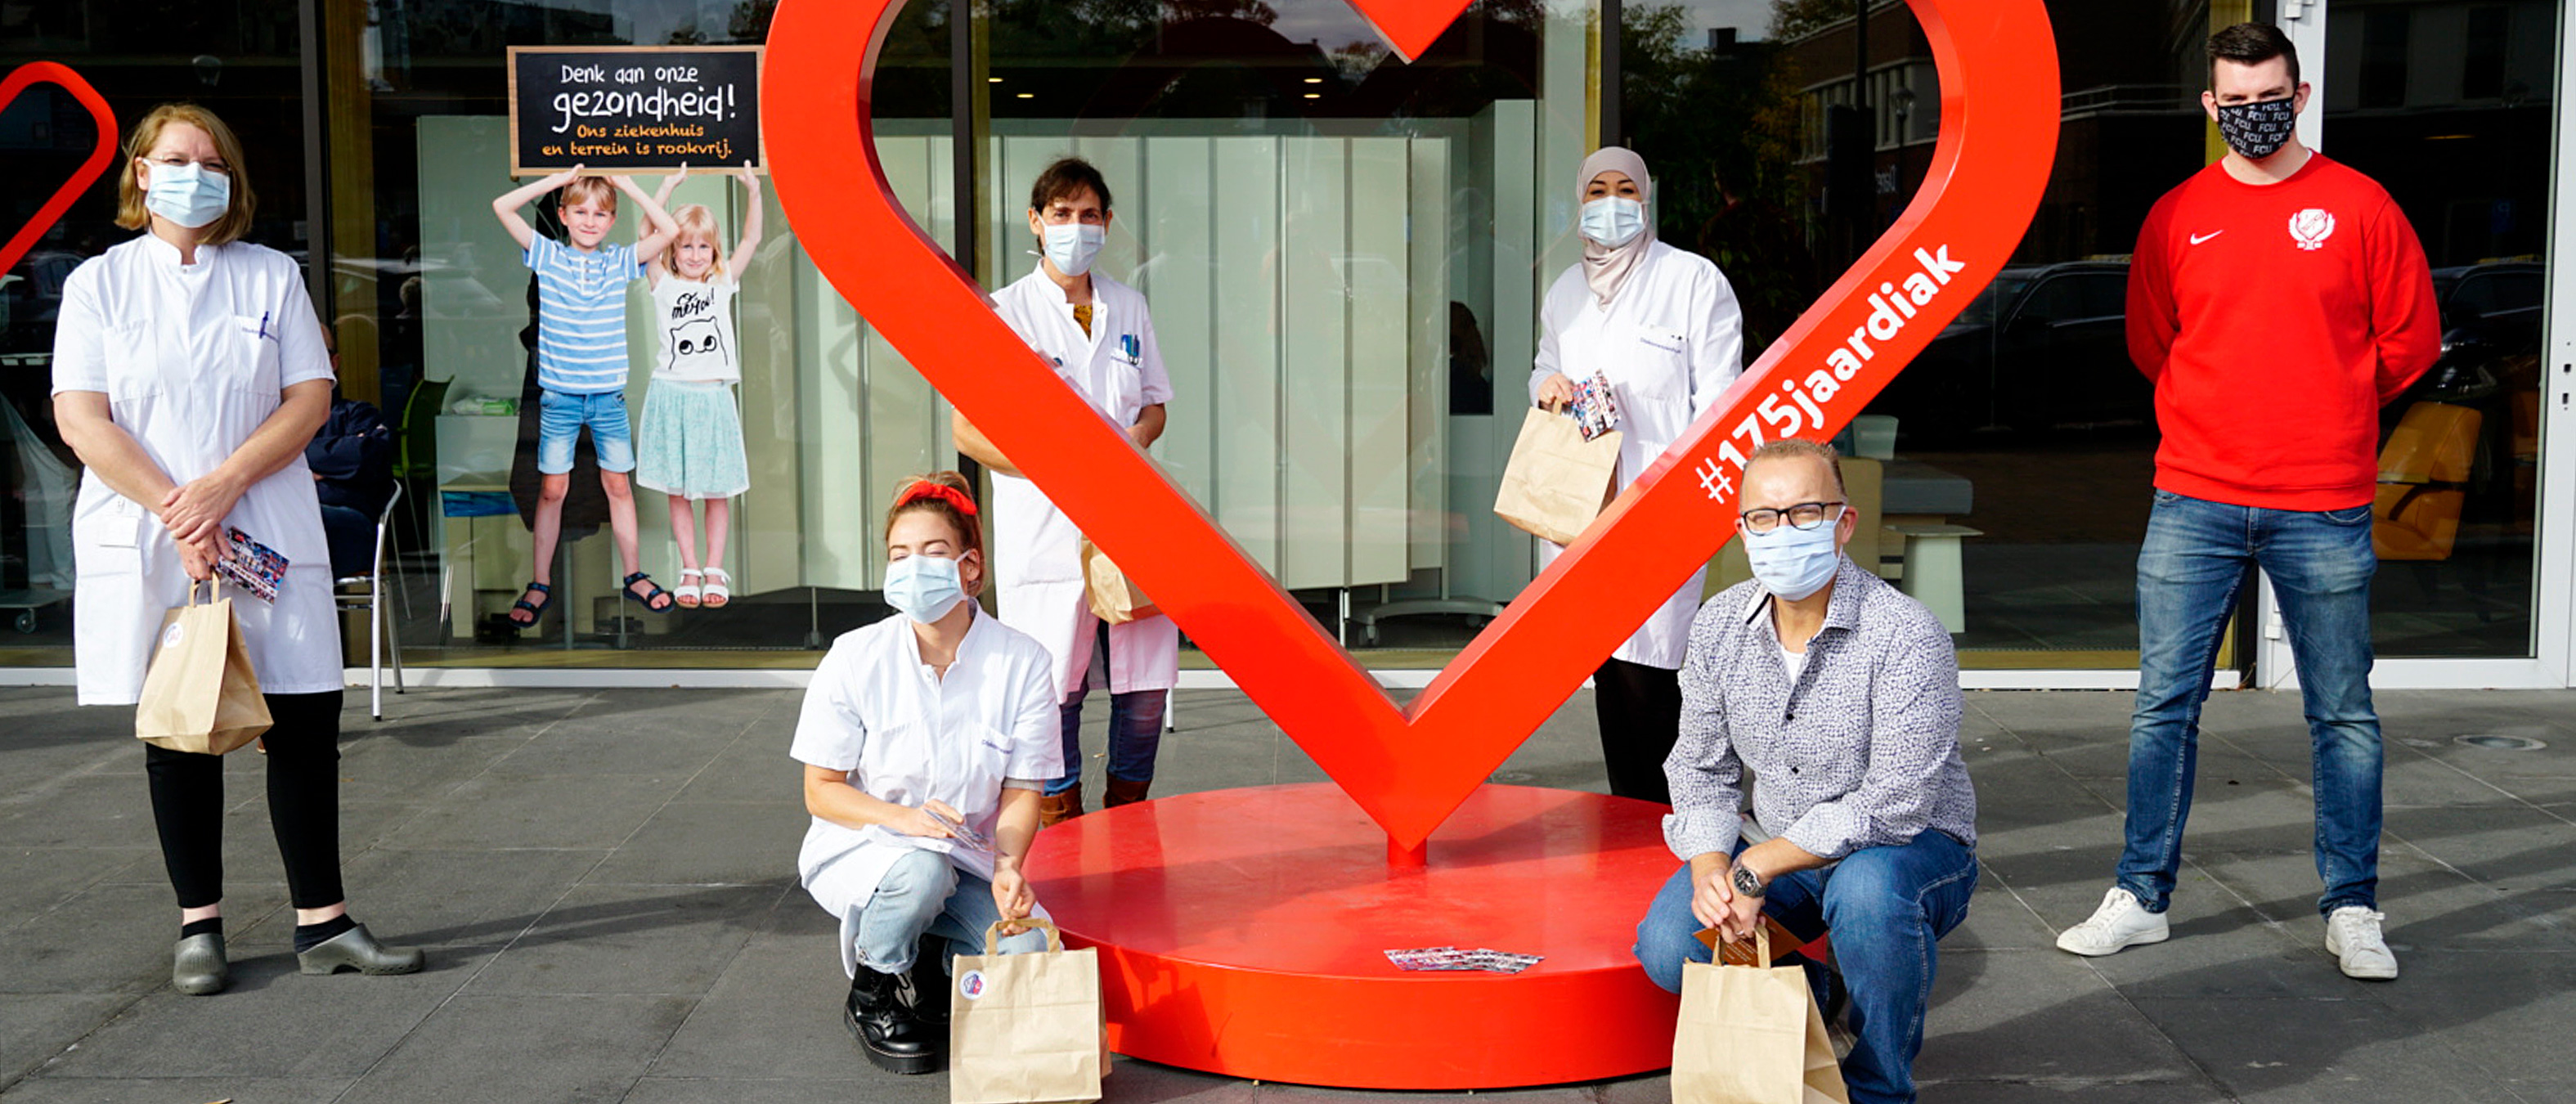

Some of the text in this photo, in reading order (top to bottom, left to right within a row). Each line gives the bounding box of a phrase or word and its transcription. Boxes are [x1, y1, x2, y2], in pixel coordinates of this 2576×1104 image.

[560, 64, 698, 84] Denk aan onze
[552, 83, 736, 132] gezondheid!
[2247, 110, 2267, 122] FCU
[2273, 112, 2289, 122] FCU
[577, 123, 704, 138] Ons ziekenhuis
[2234, 118, 2251, 130] FCU
[2258, 123, 2277, 132] FCU
[2230, 135, 2247, 148] FCU
[2253, 145, 2273, 155] FCU
[2243, 132, 2263, 143] FCU
[542, 138, 733, 159] en terrein is rookvrij.
[1695, 244, 1965, 505] #175jaardiak
